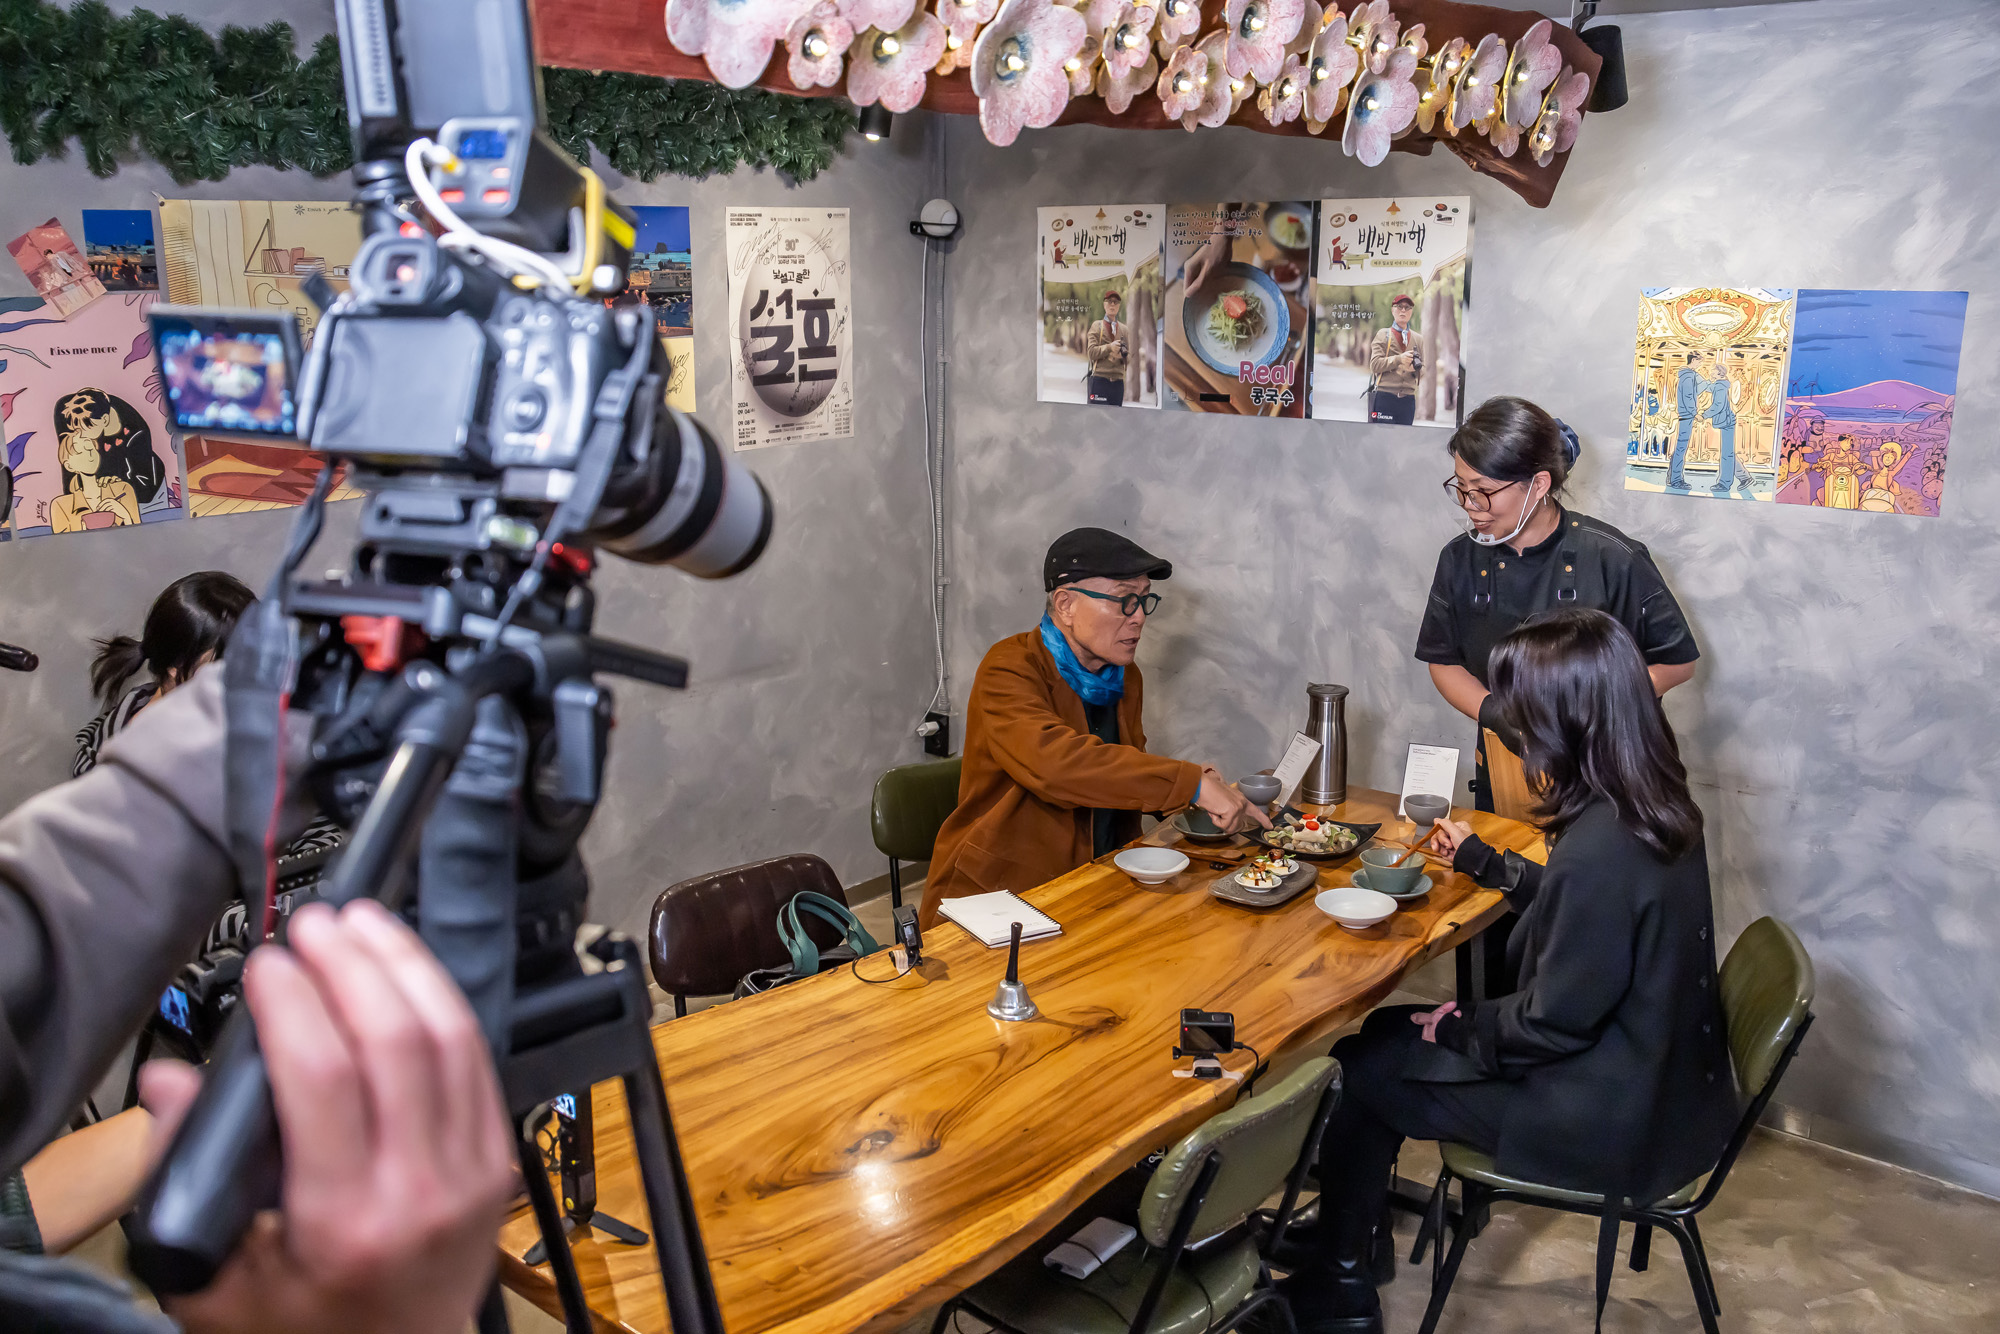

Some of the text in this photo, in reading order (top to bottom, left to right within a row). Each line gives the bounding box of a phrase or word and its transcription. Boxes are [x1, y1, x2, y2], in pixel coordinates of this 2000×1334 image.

[1073, 224, 1127, 257] 백반기행
[1358, 220, 1426, 257] 백반기행
[49, 346, 118, 356] Kiss me more
[1239, 360, 1296, 385] Real
[1250, 387, 1295, 407] 콩국수
